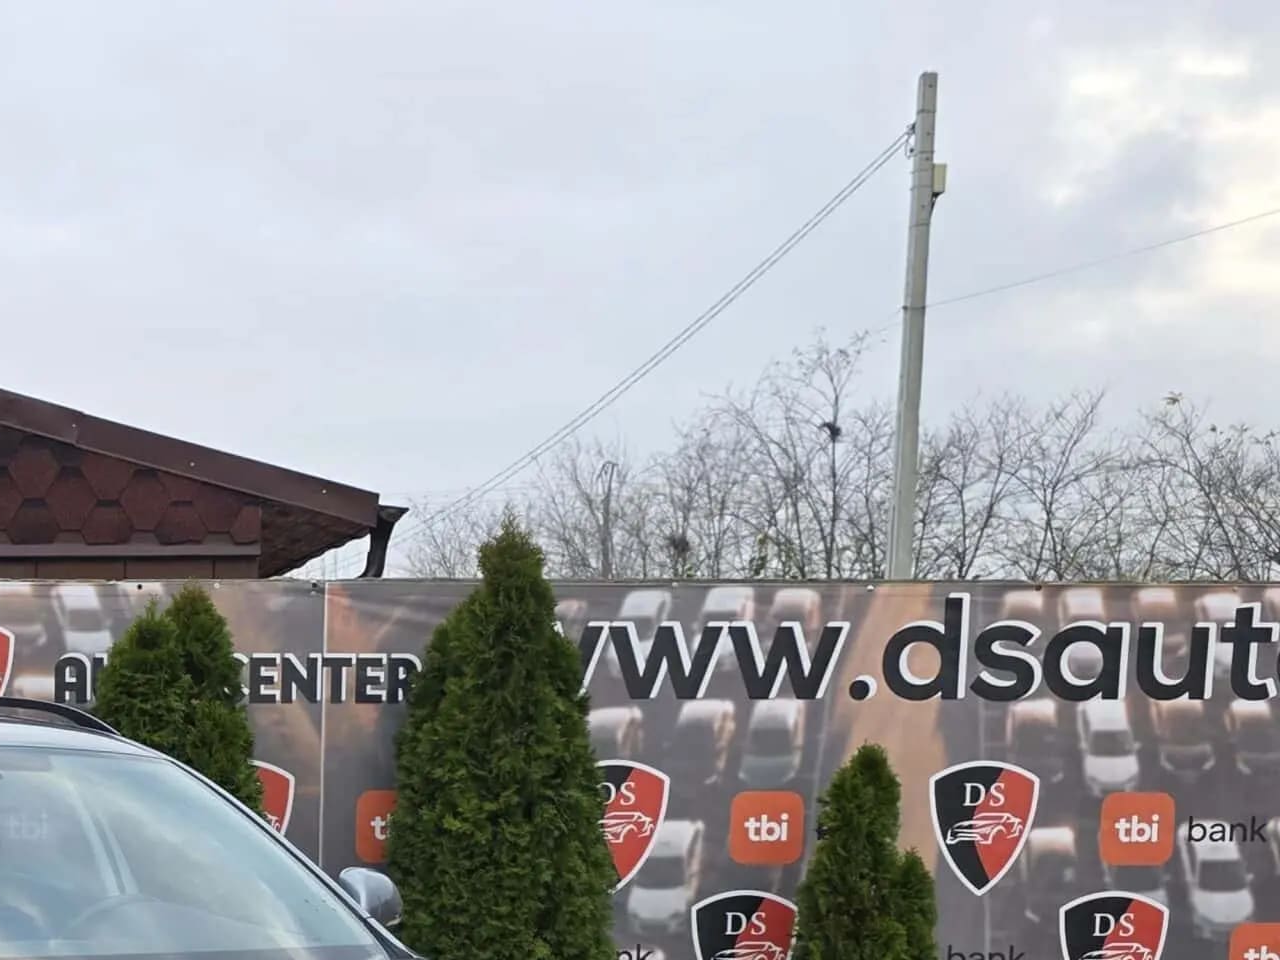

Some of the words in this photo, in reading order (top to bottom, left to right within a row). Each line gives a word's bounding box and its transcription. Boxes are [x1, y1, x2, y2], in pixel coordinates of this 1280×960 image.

[551, 592, 1280, 701] ww.dsaut
[225, 653, 422, 704] ENTER
[963, 783, 1005, 806] DS
[744, 813, 789, 841] tbi
[1115, 814, 1159, 842] tbi
[1187, 815, 1267, 842] bank
[725, 912, 766, 935] DS
[1092, 913, 1135, 936] DS
